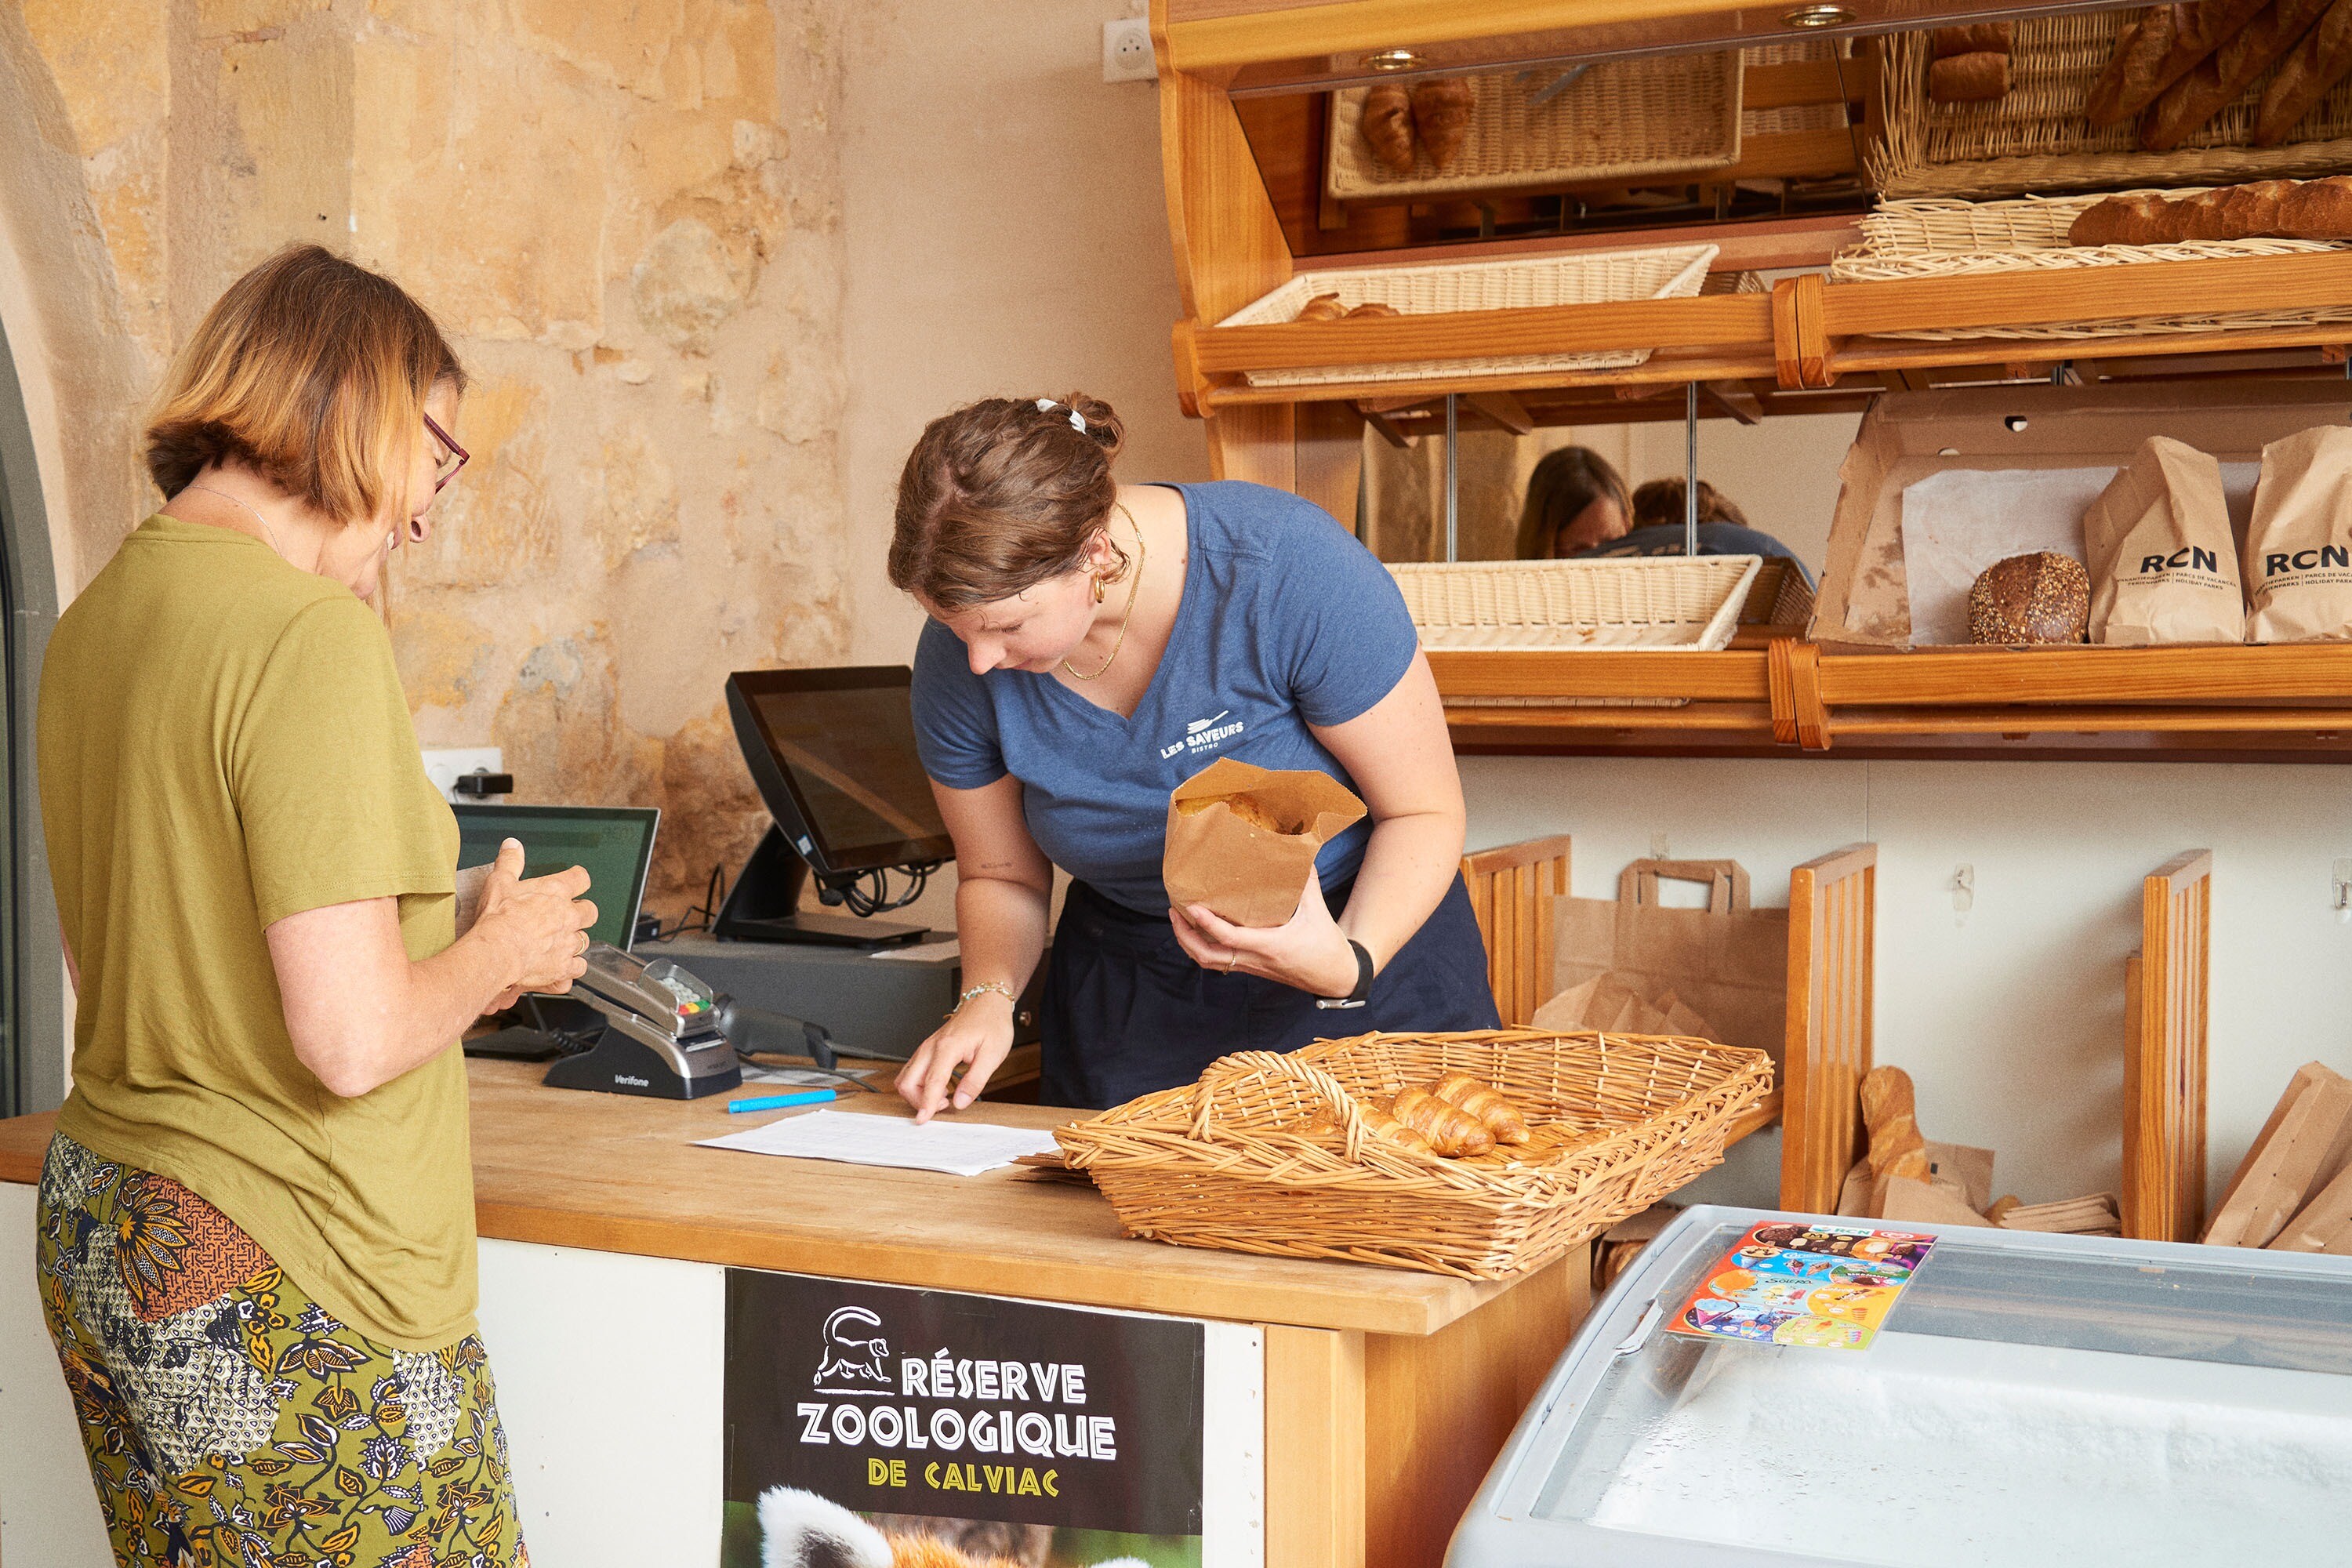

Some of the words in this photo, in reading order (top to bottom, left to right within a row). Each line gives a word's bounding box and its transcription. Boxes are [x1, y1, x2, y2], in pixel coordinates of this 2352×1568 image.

[2140, 546, 2217, 573] RCN
[2266, 545, 2350, 577] RCN
[1160, 741, 1185, 759] LES
[1185, 721, 1244, 747] SAVEURS
[1191, 742, 1219, 753] BISTRO
[614, 1074, 650, 1087] Verifone
[901, 1346, 1087, 1405] RÉSERVE
[797, 1401, 1118, 1461] ZOOLOGIQUE
[868, 1457, 907, 1488] DE
[924, 1460, 1060, 1498] CALVIAC
